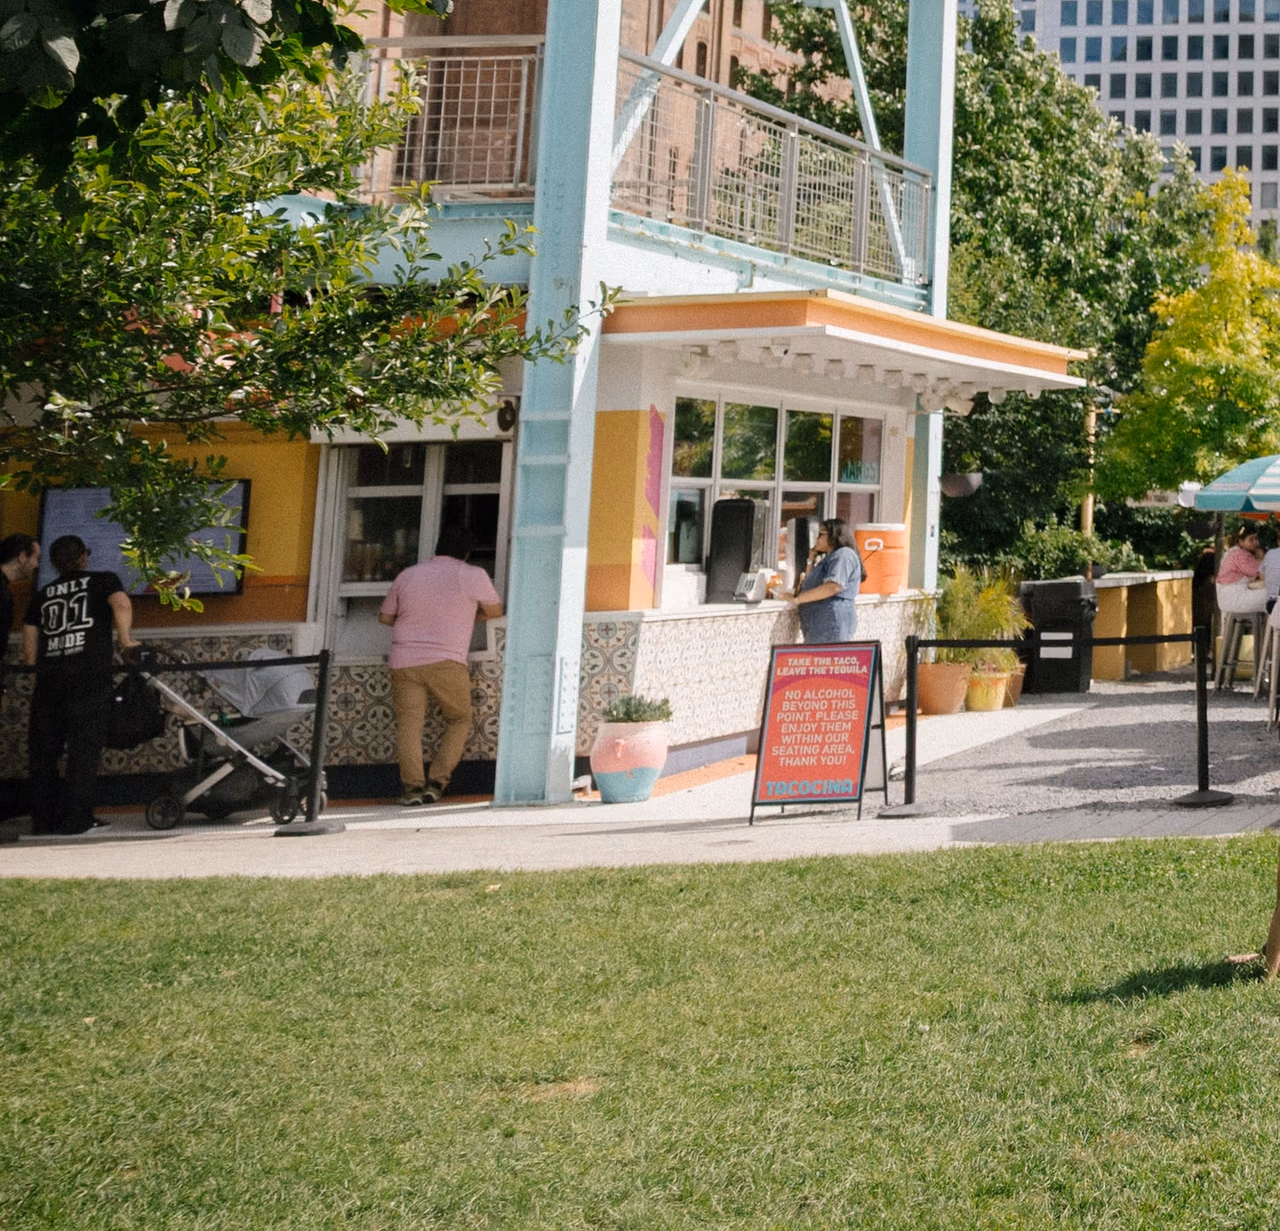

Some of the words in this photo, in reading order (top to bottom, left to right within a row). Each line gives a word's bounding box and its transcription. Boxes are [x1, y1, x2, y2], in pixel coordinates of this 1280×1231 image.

[46, 576, 91, 598] ONLY
[41, 592, 94, 635] 01
[787, 657, 811, 666] TAKE
[813, 657, 831, 665] THE
[777, 667, 806, 675] LEAVE
[808, 666, 827, 675] THE
[829, 665, 868, 674] TEQUILA
[785, 690, 801, 700] NO
[803, 689, 856, 699] ALCOHOL
[782, 700, 828, 711] BEYOND
[831, 699, 856, 709] THIS
[776, 711, 812, 722] POINT.
[815, 710, 859, 721] PLEASE
[781, 723, 817, 733] ENJOY
[820, 722, 852, 732] THEM
[781, 733, 822, 744] WITHIN
[825, 733, 849, 743] OUR
[771, 745, 820, 756] SEATING
[779, 756, 817, 767] THANK
[820, 755, 847, 766] YOU!
[766, 778, 853, 796] TACOCINA
